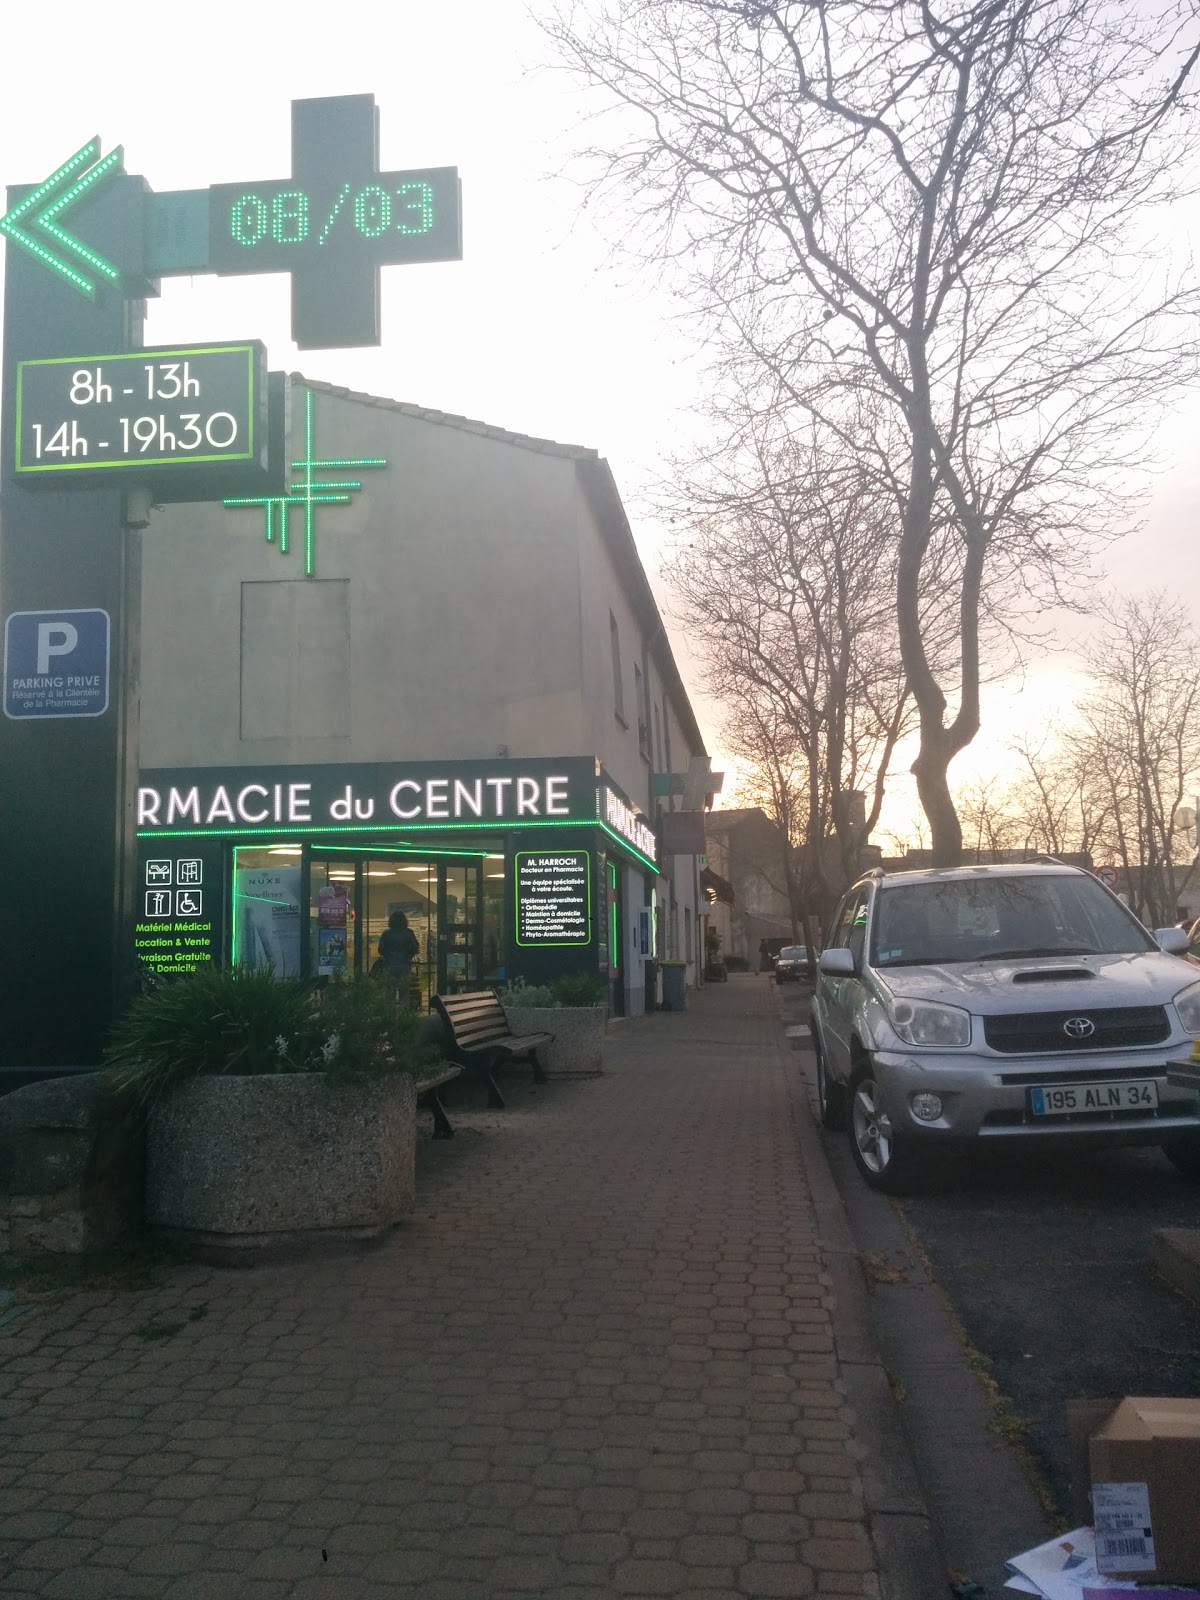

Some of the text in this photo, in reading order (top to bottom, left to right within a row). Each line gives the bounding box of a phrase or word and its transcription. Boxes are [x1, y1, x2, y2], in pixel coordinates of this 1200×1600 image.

[231, 183, 433, 246] 08/03
[70, 368, 112, 405] 8h
[144, 362, 200, 400] 13h
[32, 420, 88, 459] 14h
[119, 412, 238, 453] 19h30
[37, 622, 78, 674] P
[13, 675, 100, 689] PARKING PRIVE
[12, 687, 100, 700] Réservé à la Clientèle
[23, 697, 88, 708] de la Pharmacie
[329, 785, 375, 820] du
[390, 776, 570, 819] CENTRE
[538, 858, 577, 866] HARROCH
[553, 878, 585, 886] spécialisée
[135, 922, 211, 932] Matériel Médical
[135, 938, 211, 947] Location & Vente
[1045, 1086, 1152, 1110] 195 ALN 34
